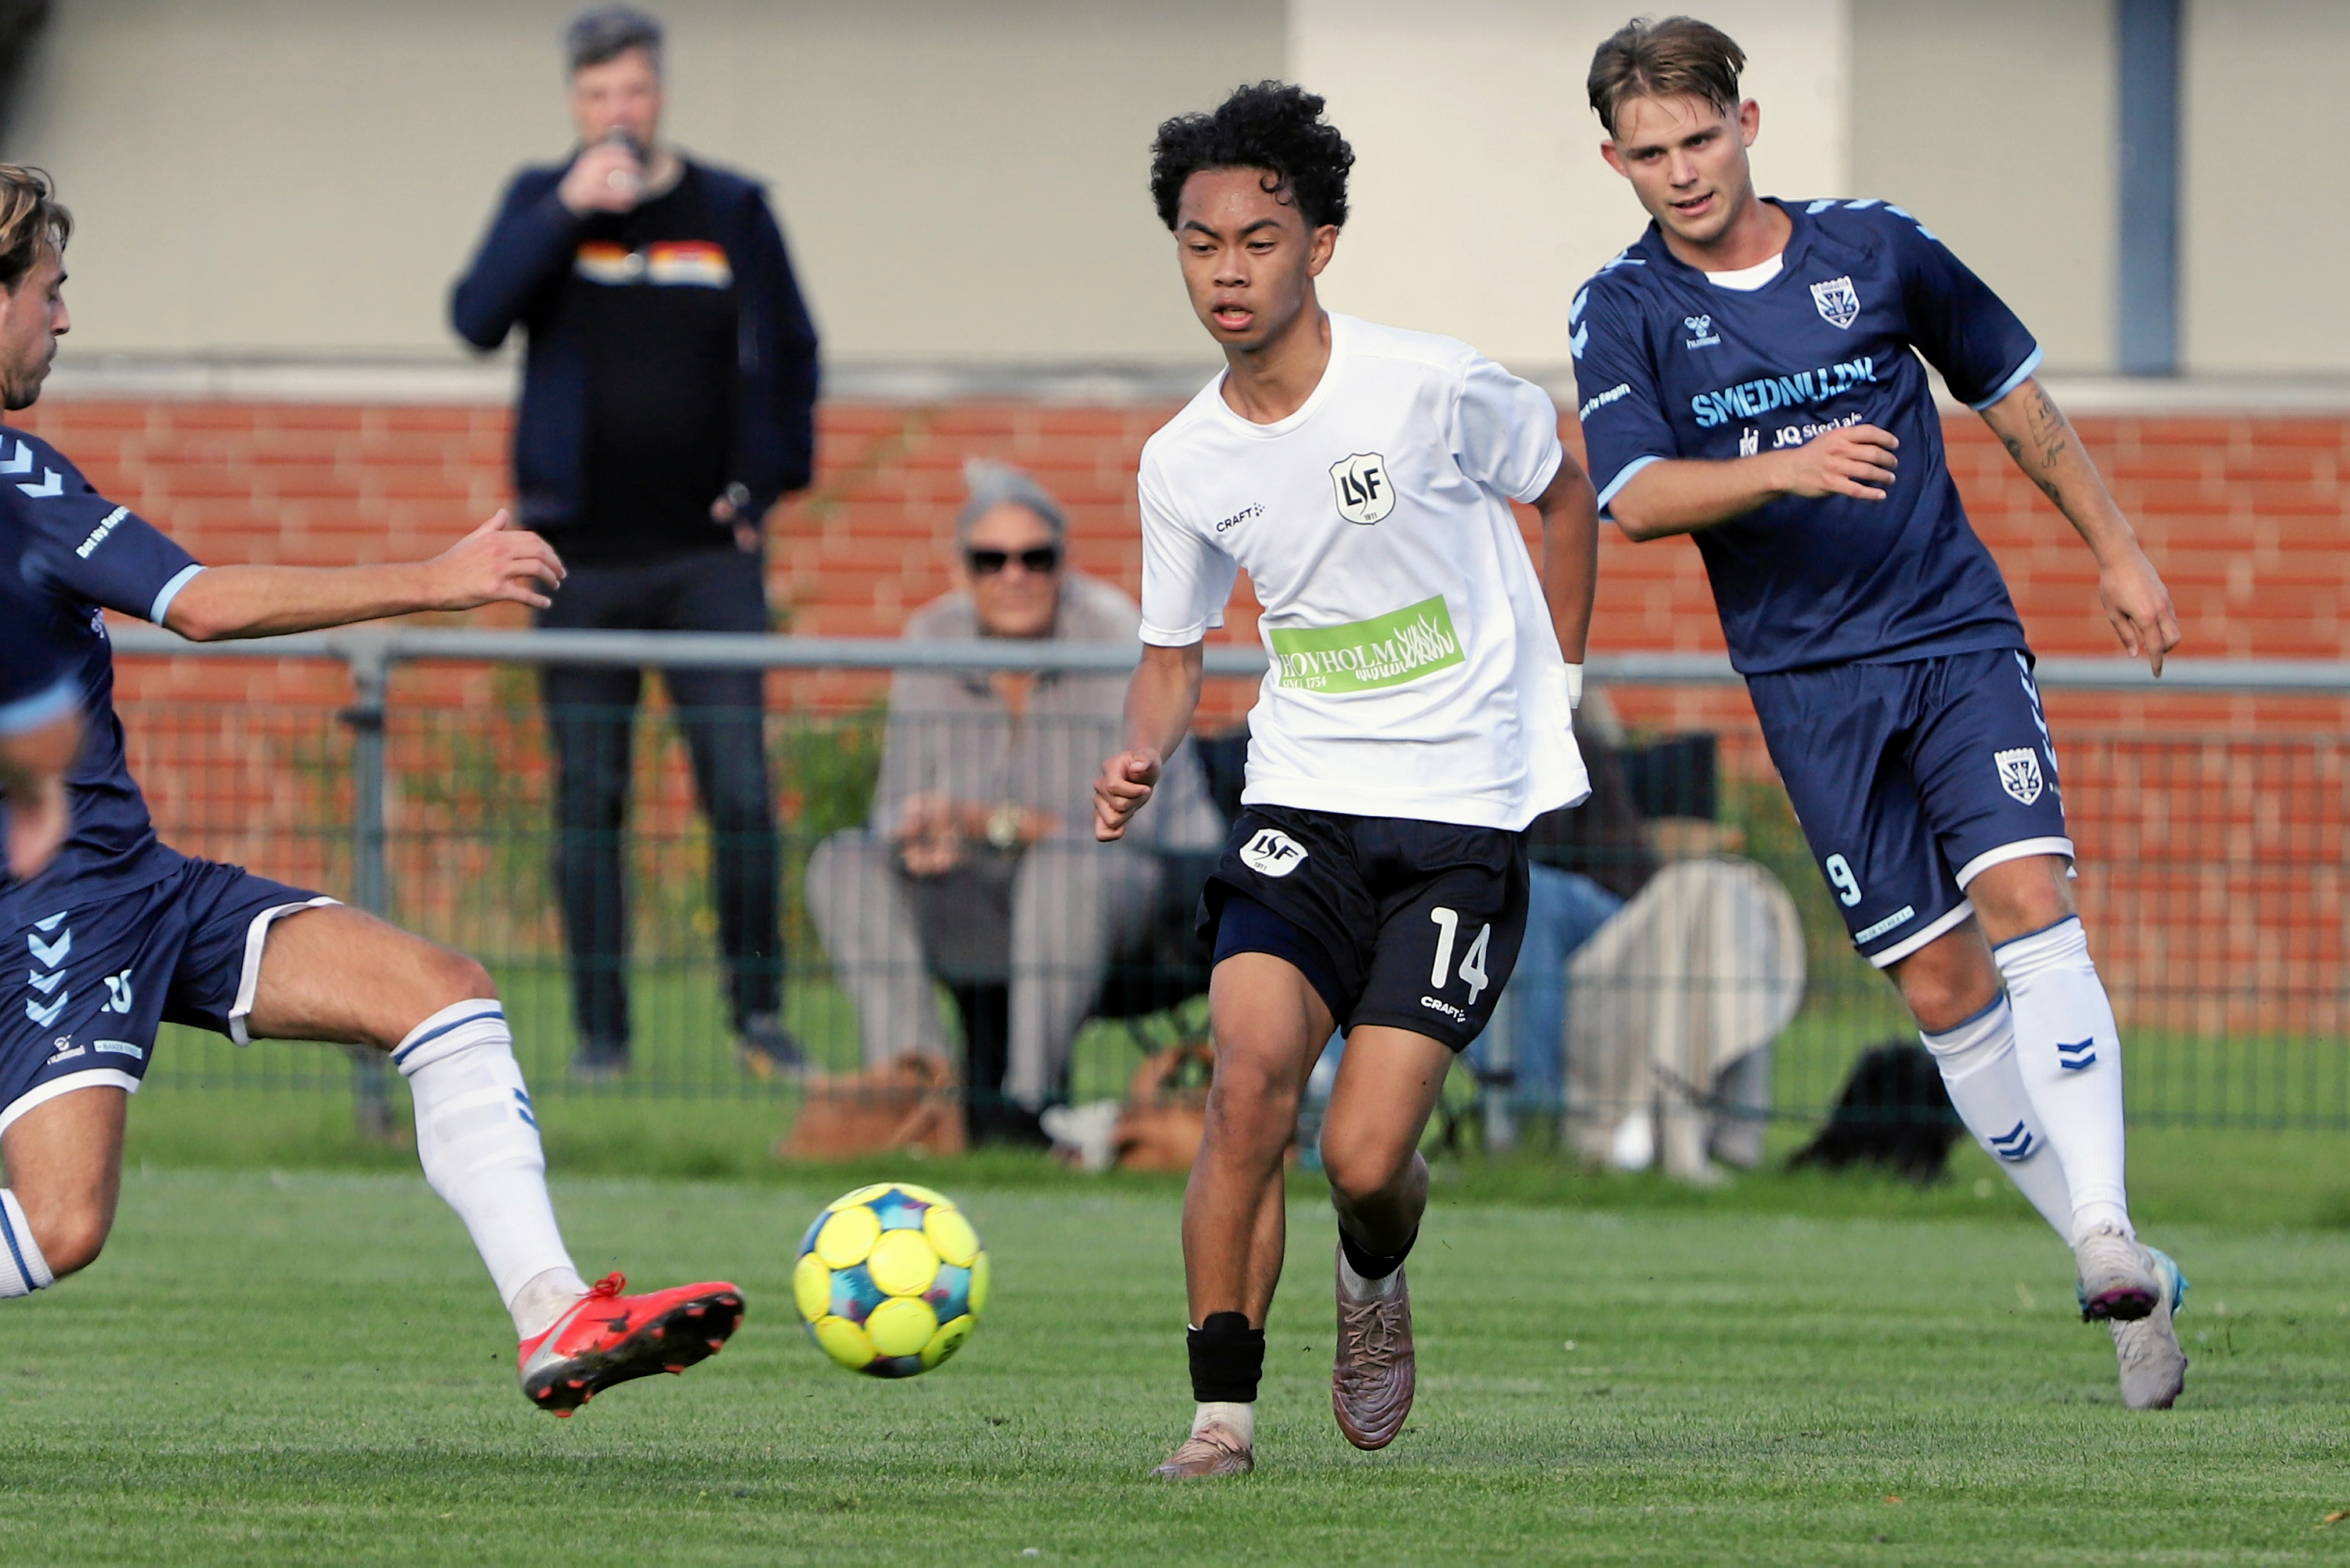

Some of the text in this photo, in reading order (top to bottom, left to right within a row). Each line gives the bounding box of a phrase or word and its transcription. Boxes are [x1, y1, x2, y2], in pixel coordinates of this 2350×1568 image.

[1773, 425, 1802, 449] JQ
[1340, 459, 1381, 516] LSF
[1216, 507, 1253, 533] CRAFT
[76, 537, 99, 558] Det
[90, 526, 109, 542] Ny
[1279, 638, 1401, 677] HOVHOLM
[1306, 676, 1327, 688] 1754
[1252, 834, 1300, 861] LSF
[1826, 853, 1862, 908] 9
[1430, 907, 1491, 1005] 14
[1420, 995, 1460, 1018] CRAFT
